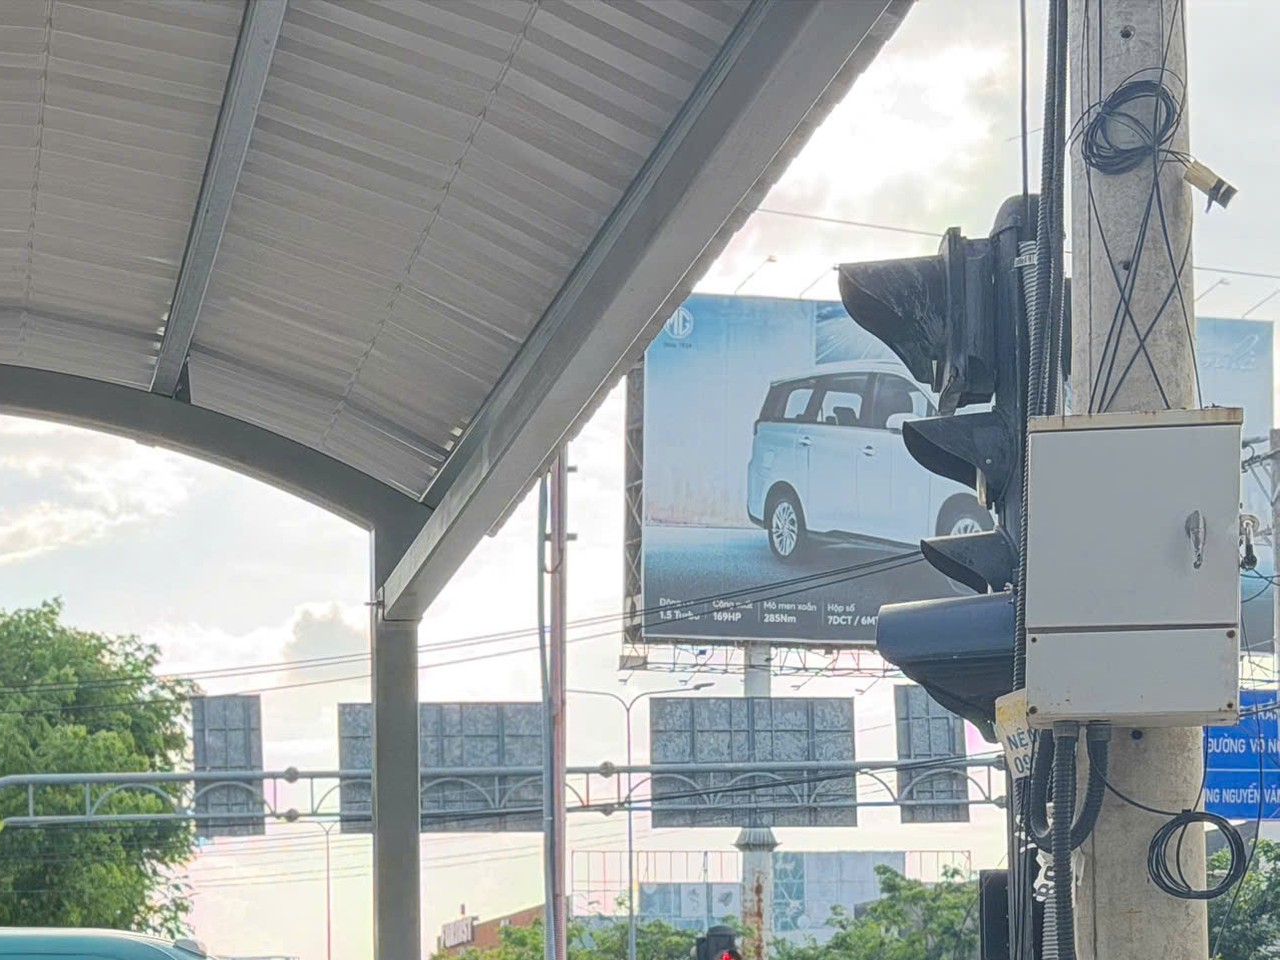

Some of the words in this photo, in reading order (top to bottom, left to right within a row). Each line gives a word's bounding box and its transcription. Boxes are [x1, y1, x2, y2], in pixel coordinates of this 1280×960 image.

[660, 610, 672, 620] 1.5
[713, 611, 742, 621] 169HP
[763, 613, 797, 623] 285Nm
[827, 615, 853, 625] 7DCT
